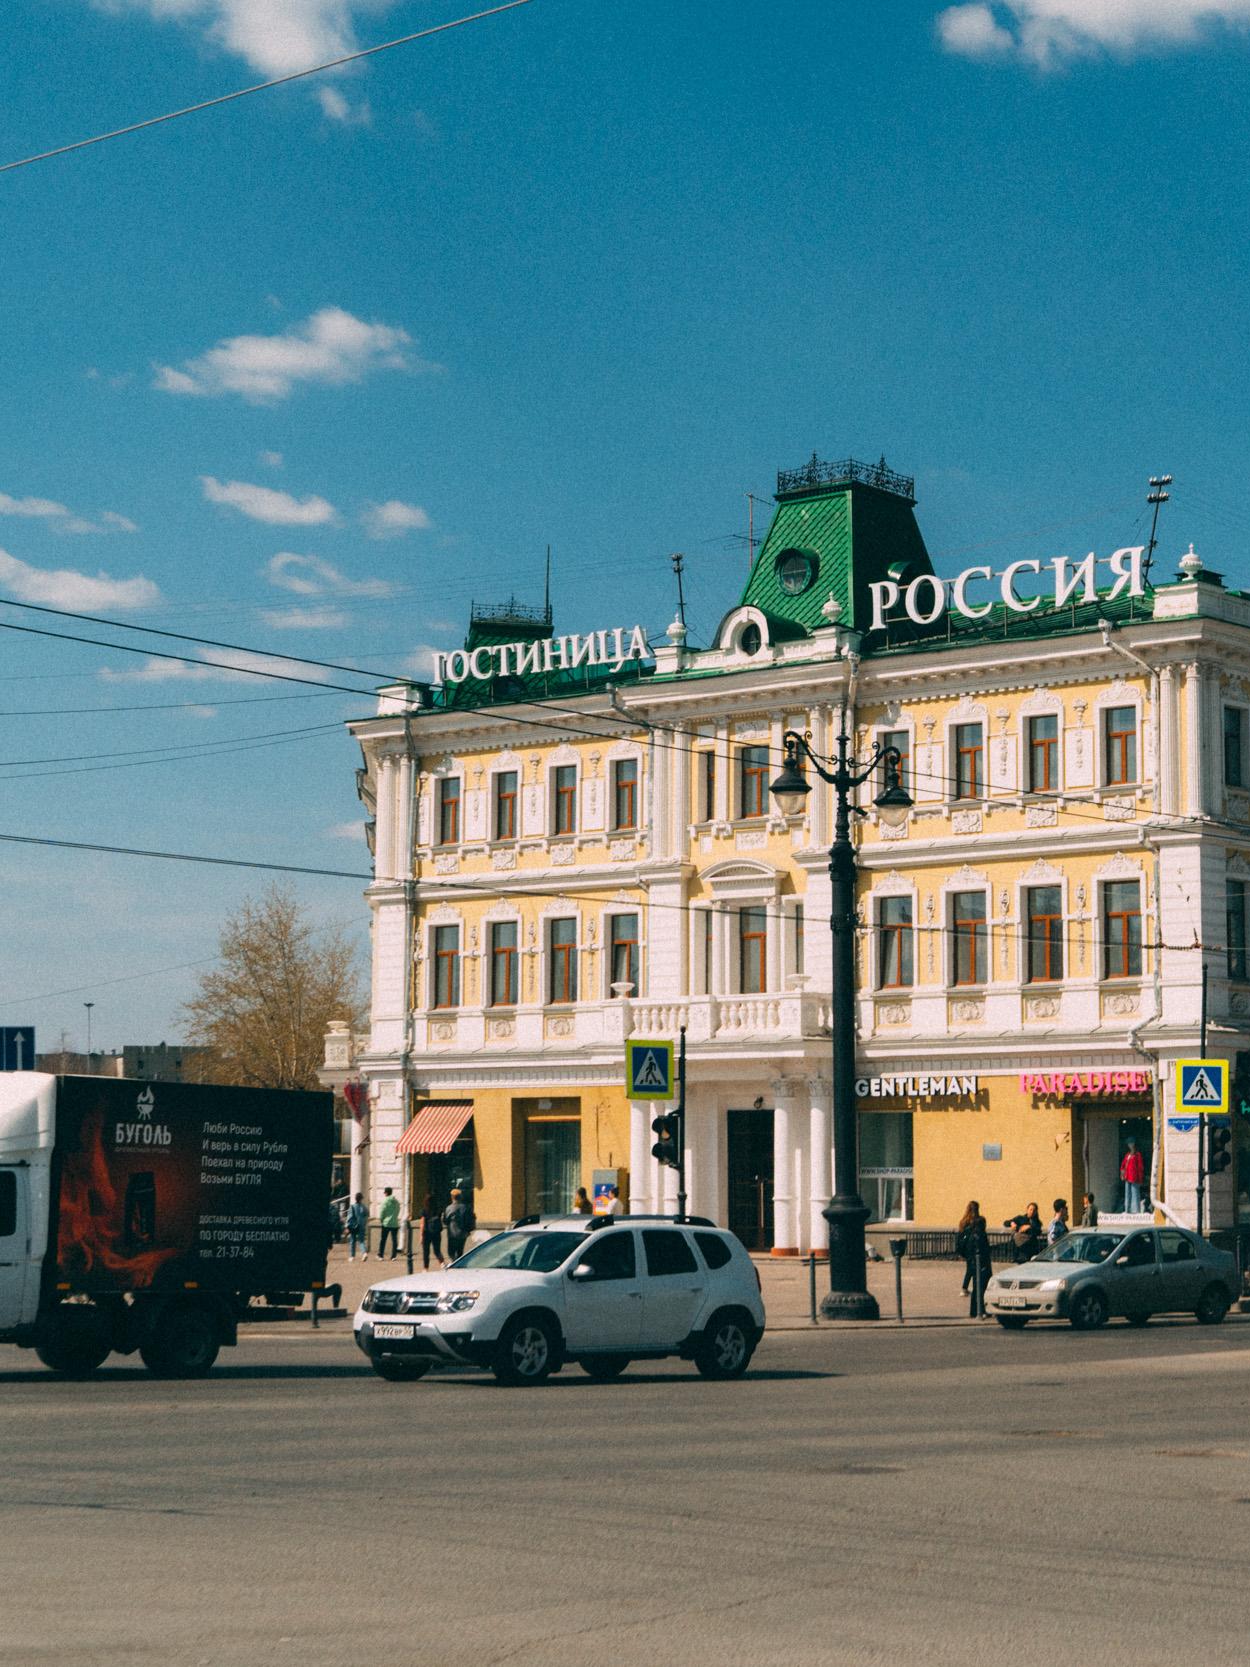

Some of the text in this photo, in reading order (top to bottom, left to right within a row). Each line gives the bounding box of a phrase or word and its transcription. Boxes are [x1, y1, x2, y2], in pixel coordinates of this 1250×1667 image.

[868, 546, 1145, 631] РОССИЯ
[431, 624, 649, 685] ГОСТИНИЦА
[854, 1075, 978, 1098] GENTLEMAN
[1020, 1071, 1150, 1093] PARADISE
[115, 1123, 172, 1145] БУГОЛЬ
[203, 1122, 263, 1136] Люби Россию
[202, 1140, 209, 1150] И
[211, 1142, 232, 1152] верь
[241, 1143, 260, 1154] силу
[263, 1142, 288, 1154] Рубля
[201, 1156, 283, 1171] Поехал на природу
[200, 1172, 262, 1185] Возьми БУГЛЯ
[200, 1230, 290, 1242] ПО ГОРОДУ БЕСПЛАТНО
[216, 1246, 254, 1258] 21-37-84
